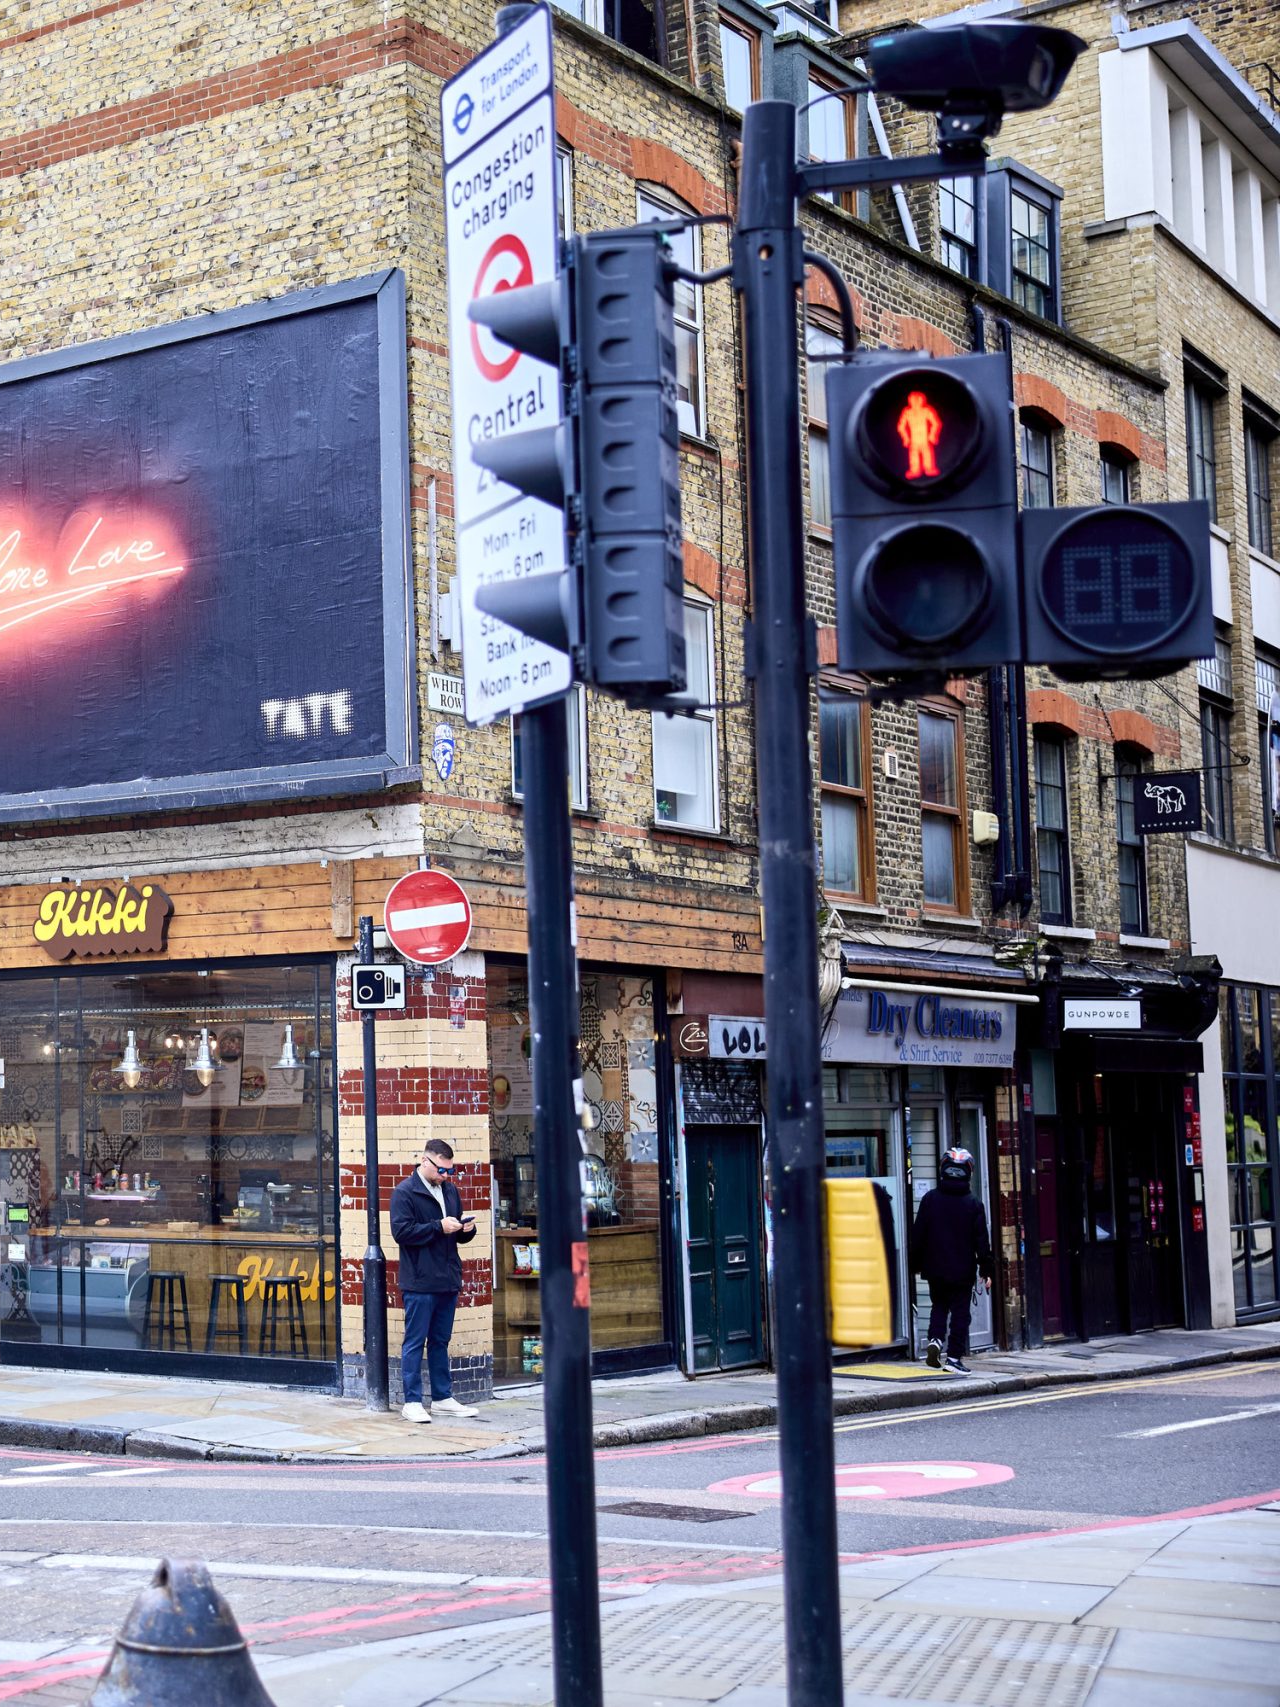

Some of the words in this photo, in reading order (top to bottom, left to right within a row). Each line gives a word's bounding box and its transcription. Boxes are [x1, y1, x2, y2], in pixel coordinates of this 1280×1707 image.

[480, 41, 532, 93] Transport
[482, 96, 496, 117] for
[499, 62, 538, 102] London
[451, 125, 545, 209] Congestion
[463, 171, 535, 239] charging
[468, 375, 544, 442] Central
[68, 517, 166, 575] Love
[482, 532, 509, 557] Mon
[520, 513, 536, 540] Fri
[514, 553, 522, 578] 6
[523, 551, 544, 575] pm
[487, 634, 516, 663] Bank
[479, 679, 511, 700] Noon
[520, 663, 528, 686] 6
[531, 659, 552, 685] pm
[260, 687, 356, 740] TATE
[33, 885, 153, 942] Kikki
[732, 933, 749, 951] 13A
[868, 991, 912, 1047] Dry
[915, 994, 1003, 1041] Cleaners
[823, 1047, 832, 1058] 12
[899, 1045, 907, 1061] &
[910, 1045, 930, 1062] Shirt
[931, 1048, 963, 1063] Service
[974, 1052, 984, 1063] 020
[231, 1255, 336, 1302] Kikk
